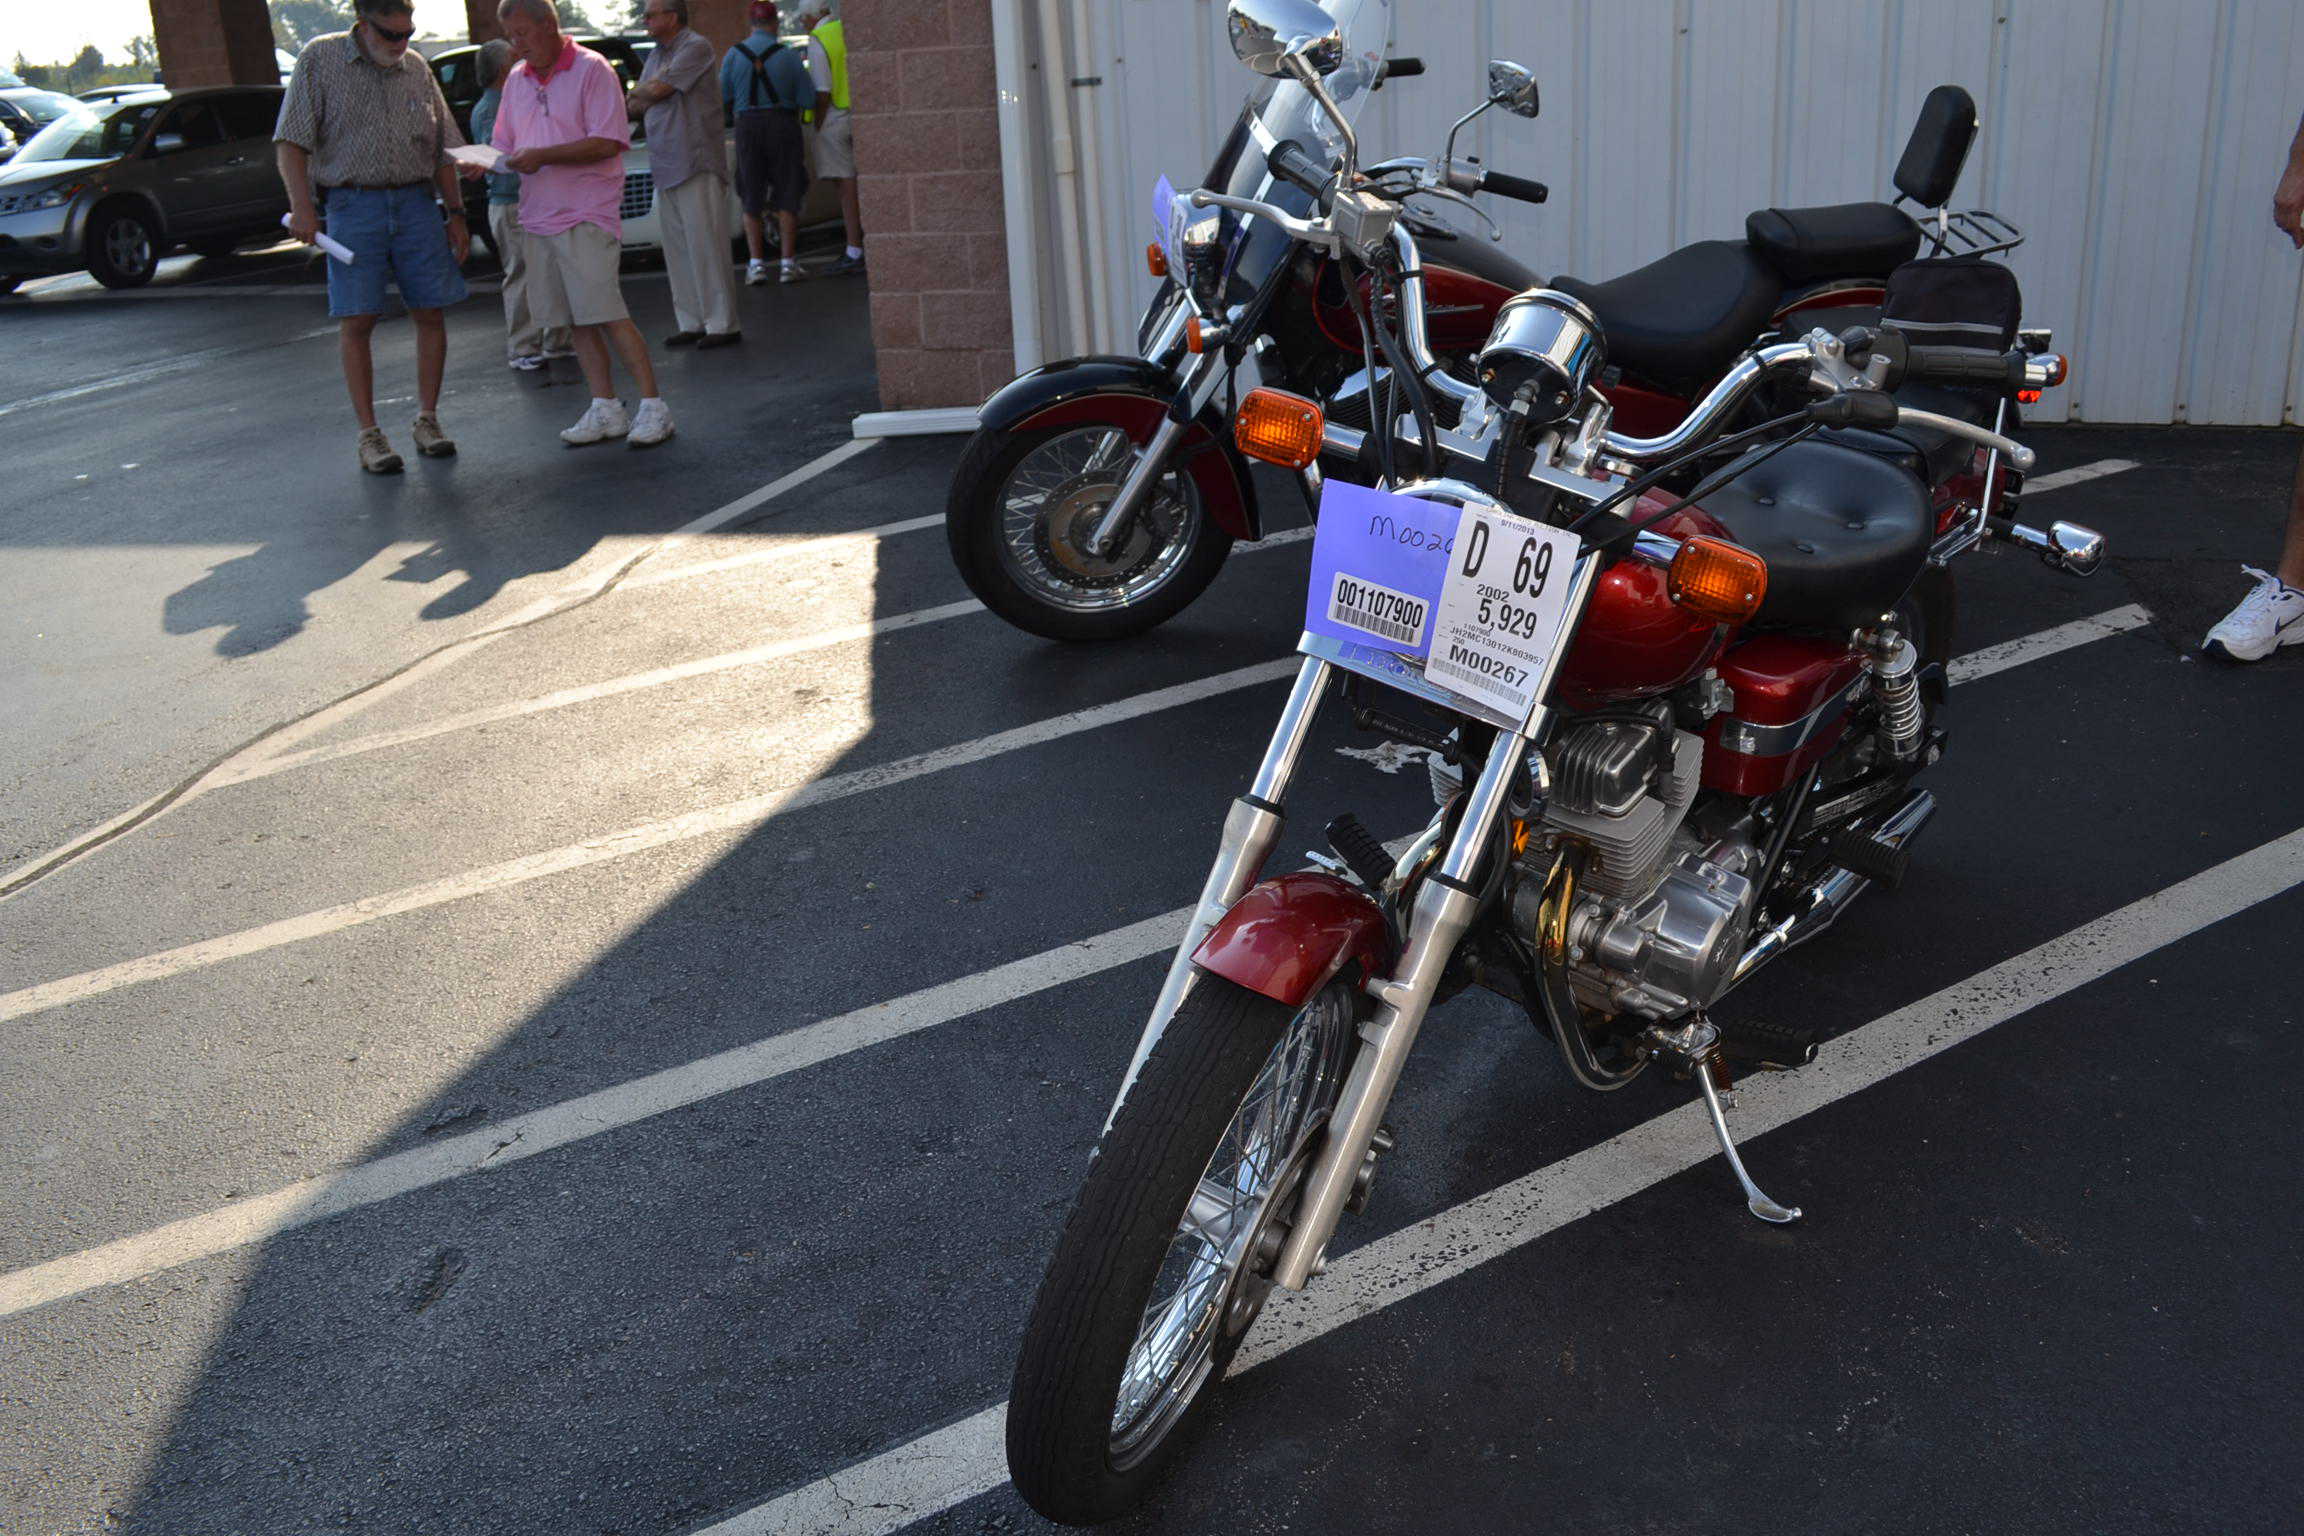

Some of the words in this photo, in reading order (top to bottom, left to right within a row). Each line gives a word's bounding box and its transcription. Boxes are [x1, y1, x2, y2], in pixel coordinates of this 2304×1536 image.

[1462, 520, 1490, 578] D
[1513, 536, 1553, 598] 69
[1337, 578, 1423, 628] 001107900
[1476, 583, 1510, 603] 2002
[1477, 598, 1538, 640] 5,929
[1449, 644, 1529, 688] M00267
